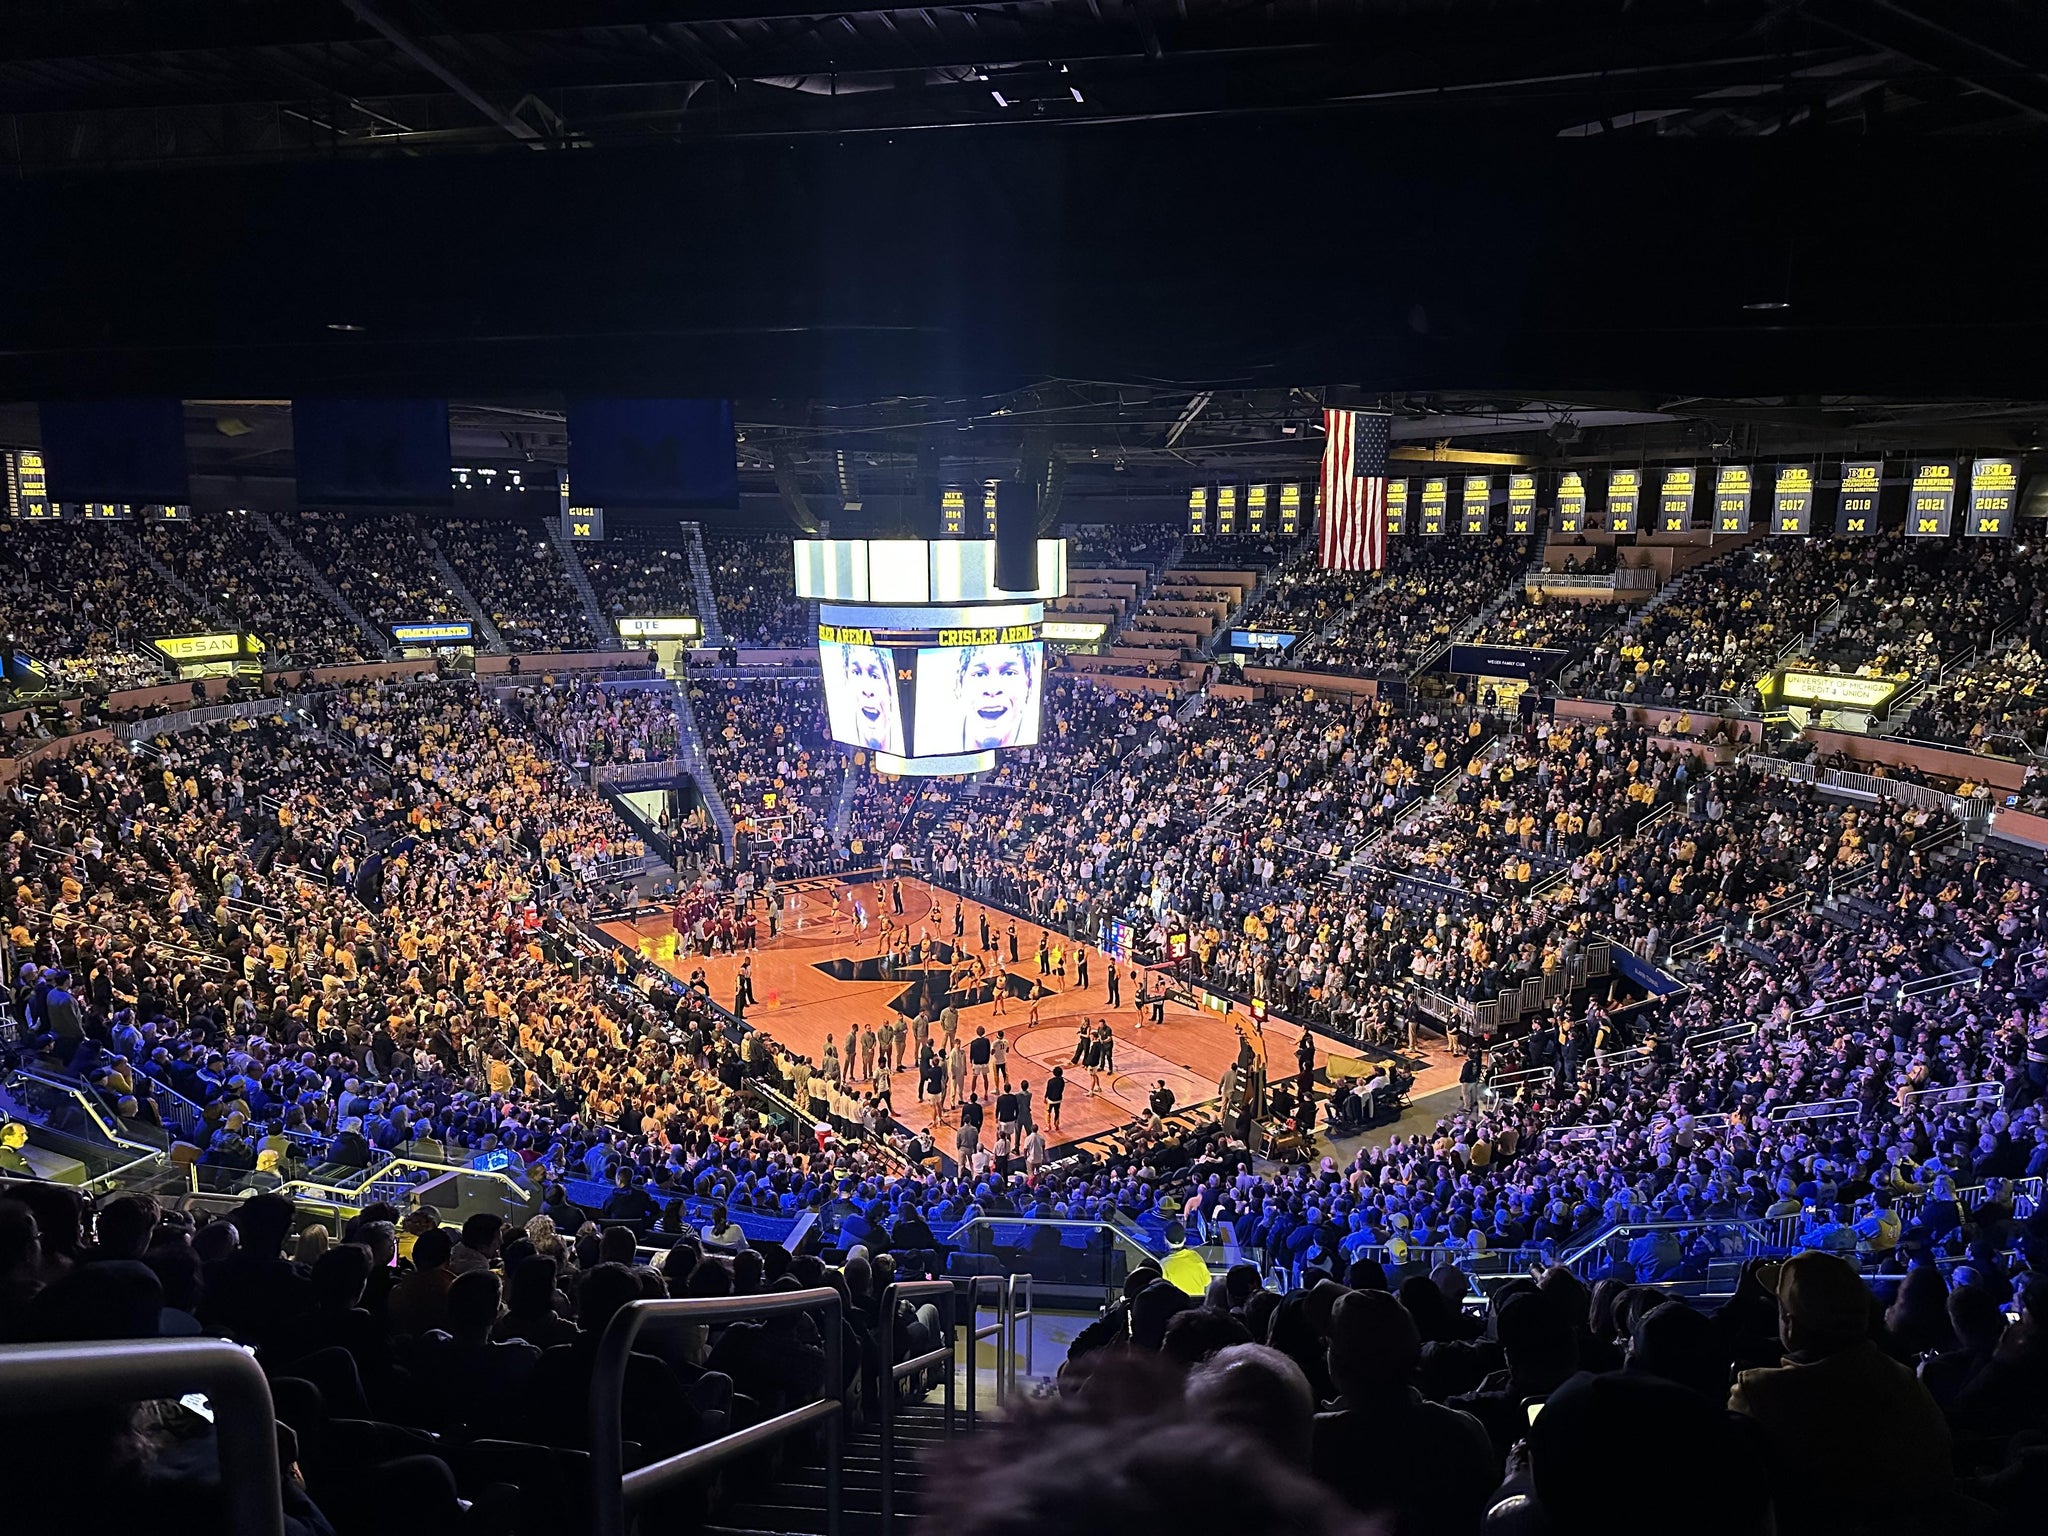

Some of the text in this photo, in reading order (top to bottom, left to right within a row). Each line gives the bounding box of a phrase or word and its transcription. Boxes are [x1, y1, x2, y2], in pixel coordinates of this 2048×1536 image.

[1512, 505, 1531, 514] 1977
[1561, 503, 1580, 514] 1985
[1611, 502, 1632, 513] 1986
[1665, 501, 1686, 512] 2012
[1720, 501, 1744, 511] 2014
[1780, 500, 1805, 510] 2017
[1845, 500, 1871, 510] 2018
[1916, 498, 1945, 511] 2021
[1975, 498, 2009, 510] 2025
[30, 504, 43, 516] M
[102, 504, 114, 516] M
[165, 506, 176, 517] M
[1467, 505, 1485, 515] 1974
[574, 524, 590, 536] M
[1388, 522, 1399, 532] M
[1426, 522, 1438, 532] M
[1468, 521, 1481, 532] M
[1514, 521, 1527, 532] M
[1562, 520, 1576, 531] M
[1613, 519, 1628, 530] M
[1666, 519, 1682, 530] M
[1722, 519, 1738, 530] M
[1782, 519, 1799, 530] M
[1848, 519, 1864, 531] M
[1918, 519, 1938, 532] M
[1979, 519, 1999, 532] M
[635, 621, 659, 629] DTE
[836, 627, 874, 646] ARENA
[939, 628, 998, 646] CRISLER
[1000, 626, 1033, 643] ARENA
[1258, 635, 1278, 643] Ruoff
[160, 639, 233, 653] NISSAN
[899, 670, 912, 680] M
[1788, 677, 1835, 687] UNIVERSITY
[1850, 683, 1892, 692] MICHIGAN
[1802, 685, 1829, 693] CREDIT
[1172, 943, 1185, 958] 30
